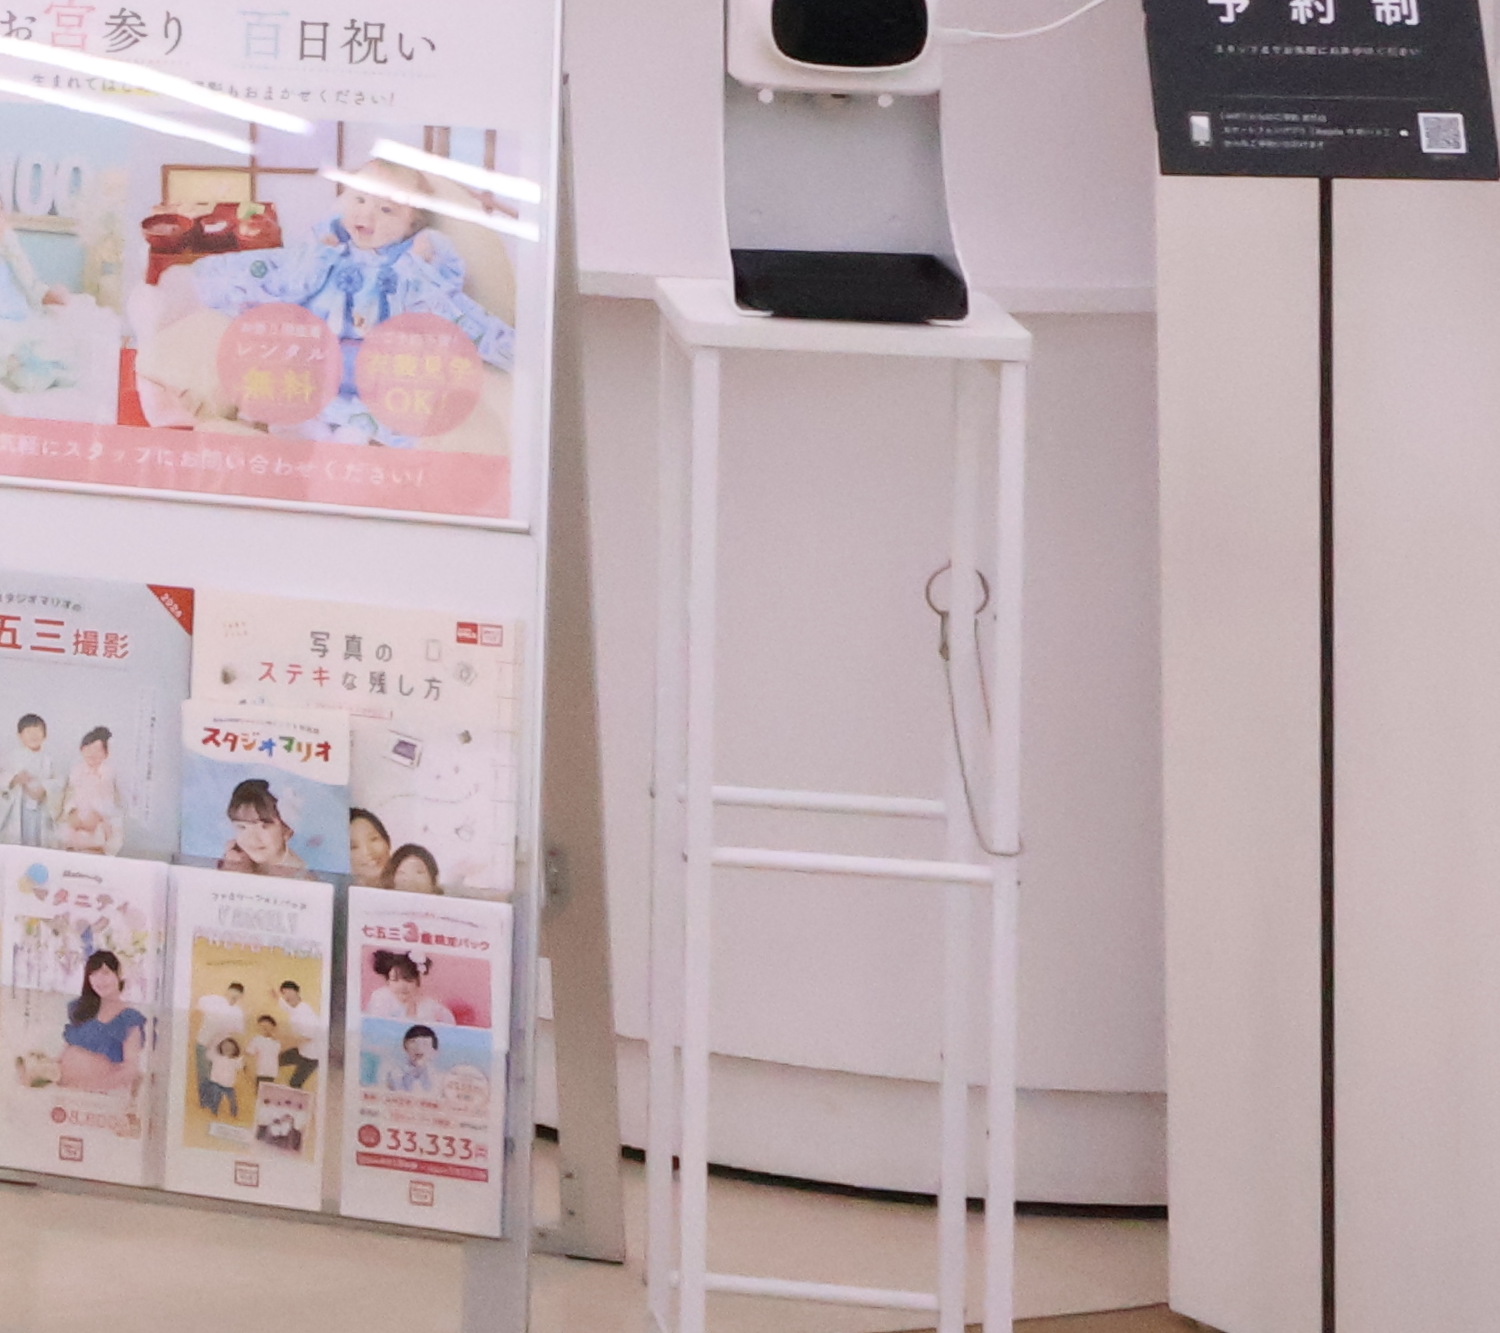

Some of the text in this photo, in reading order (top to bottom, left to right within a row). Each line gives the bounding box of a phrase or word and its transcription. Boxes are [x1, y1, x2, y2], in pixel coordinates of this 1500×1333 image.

[237, 8, 437, 65] 百日祝い
[237, 343, 326, 362] レンタル
[310, 630, 393, 663] 写真の
[258, 661, 443, 702] ステキな残し方
[201, 726, 332, 763] スタジオマリオ
